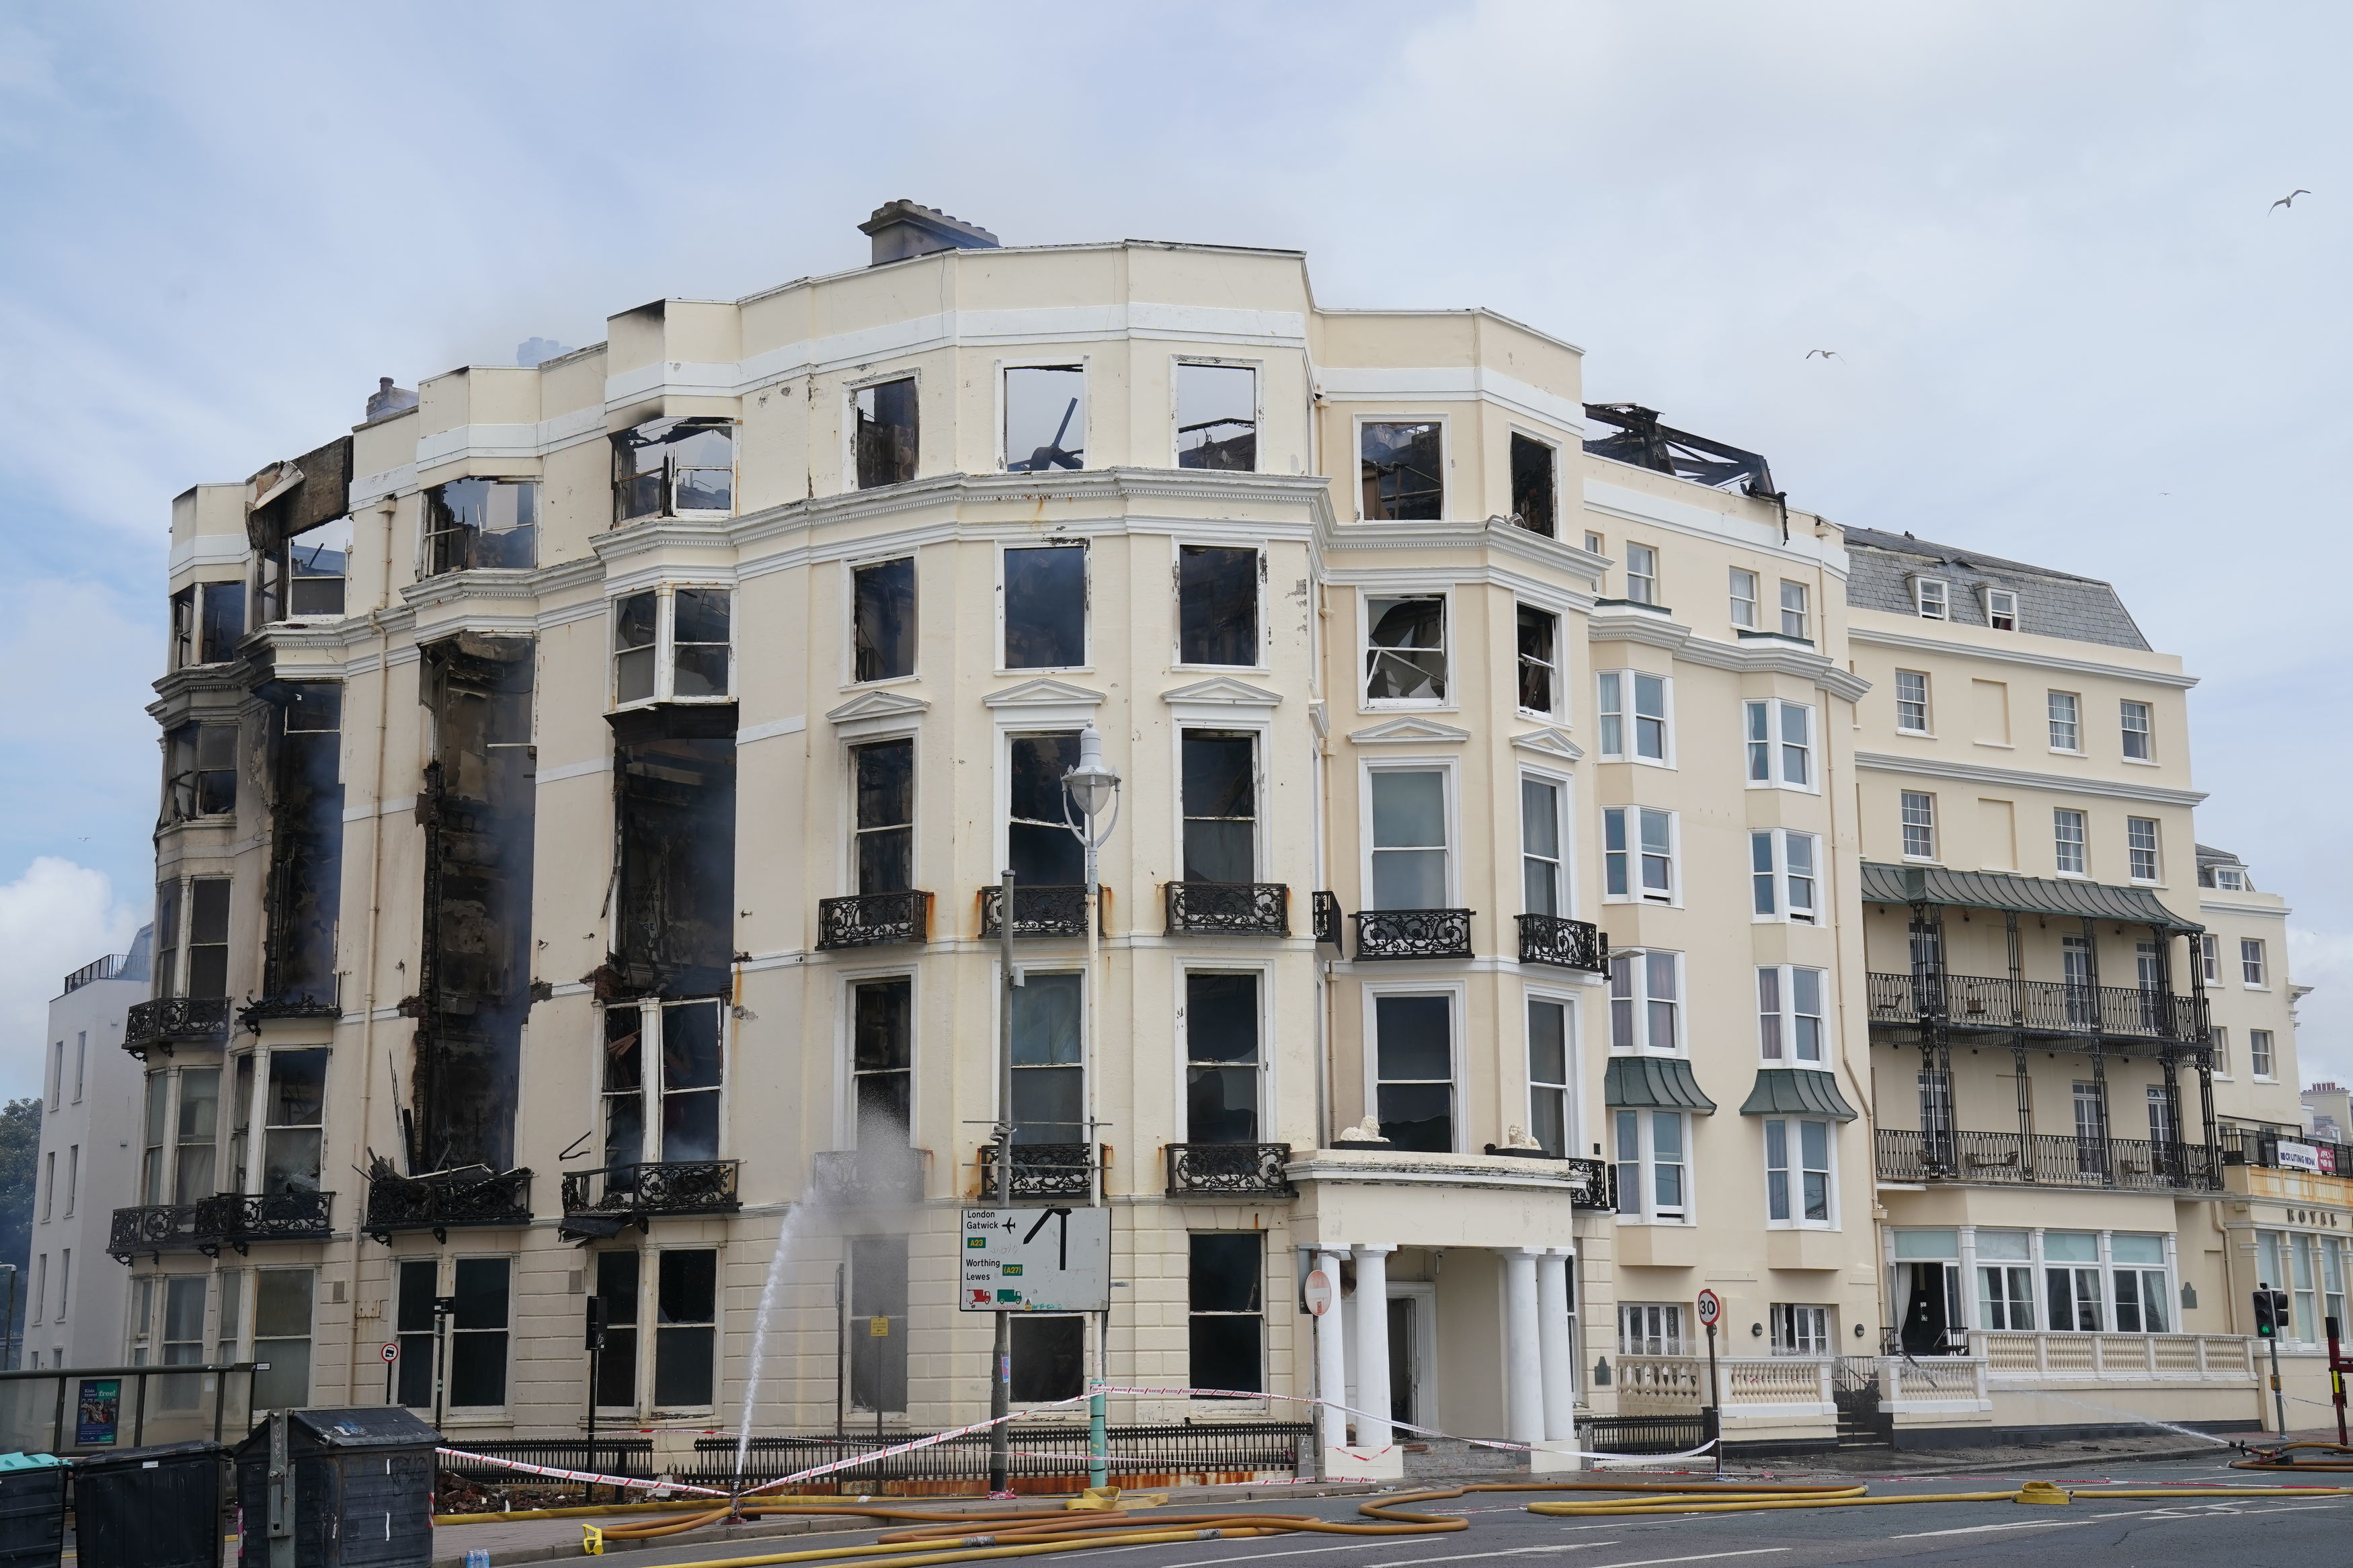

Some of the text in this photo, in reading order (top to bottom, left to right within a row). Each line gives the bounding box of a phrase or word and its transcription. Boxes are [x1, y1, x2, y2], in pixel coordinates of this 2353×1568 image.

[967, 1210, 995, 1218] London
[2287, 1208, 2337, 1227] ROYAL
[966, 1221, 999, 1229] Gatwick
[966, 1259, 1000, 1268] Worthing
[966, 1272, 990, 1280] Lewes
[1700, 1300, 1716, 1315] 30
